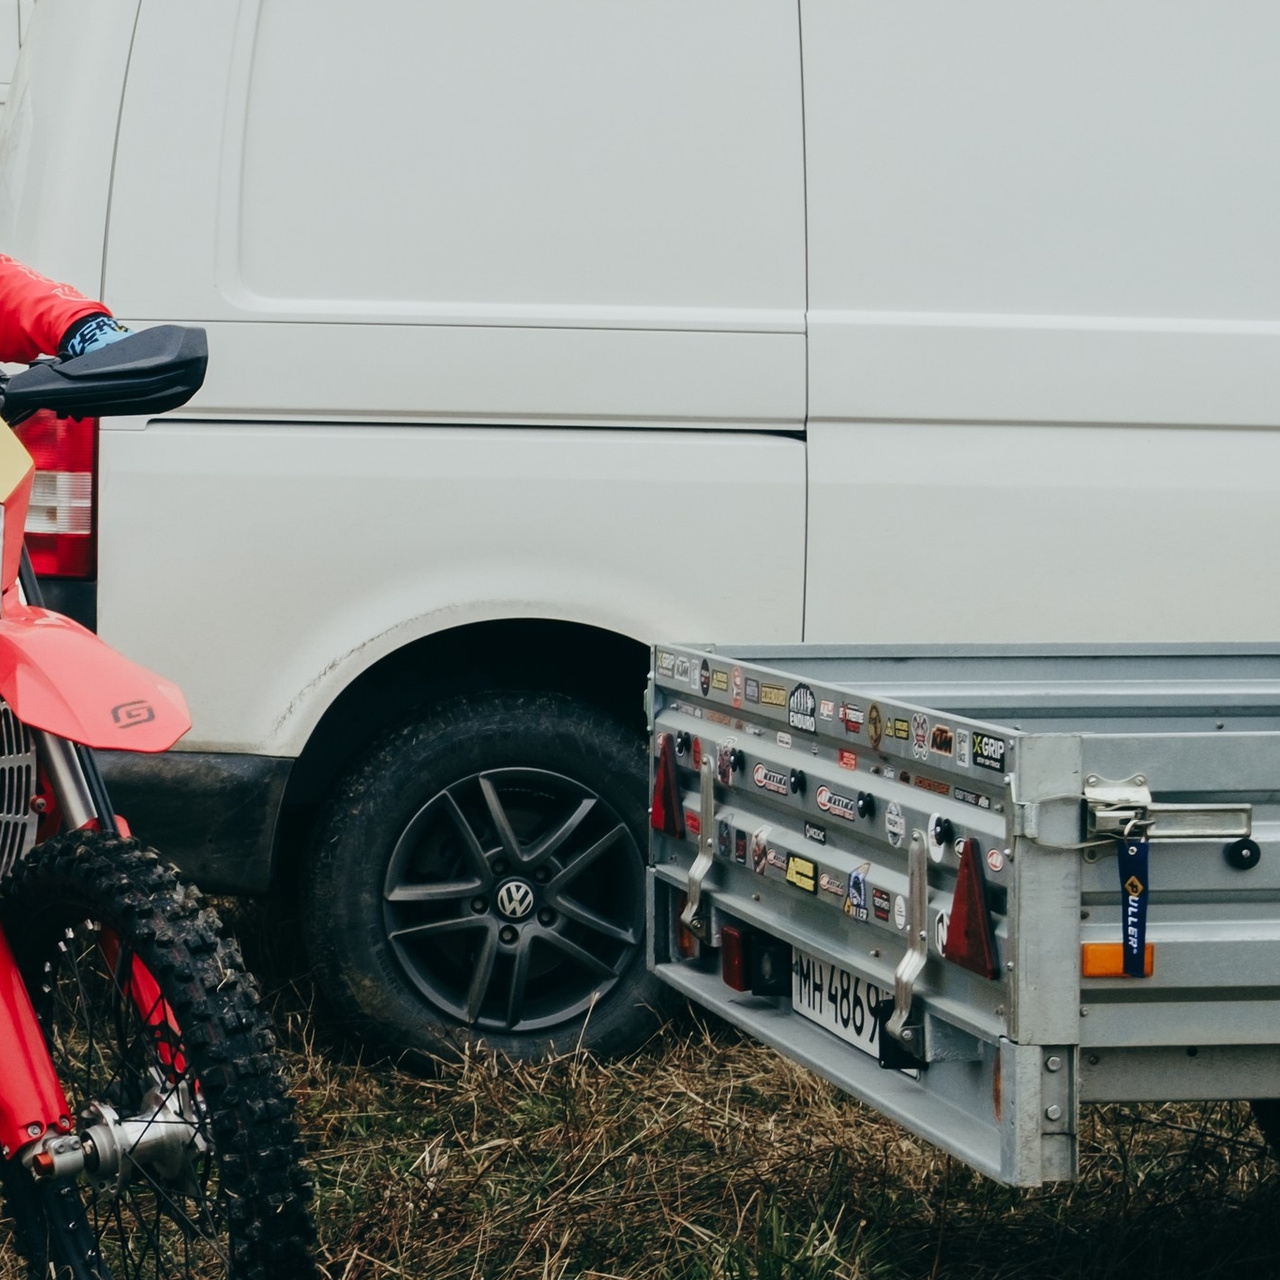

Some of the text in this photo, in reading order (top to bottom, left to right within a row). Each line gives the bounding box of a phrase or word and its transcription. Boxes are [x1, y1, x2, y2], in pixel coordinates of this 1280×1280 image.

[789, 712, 816, 733] ENDURO
[972, 734, 1005, 760] X-GRIP
[827, 964, 881, 1044] 4869
